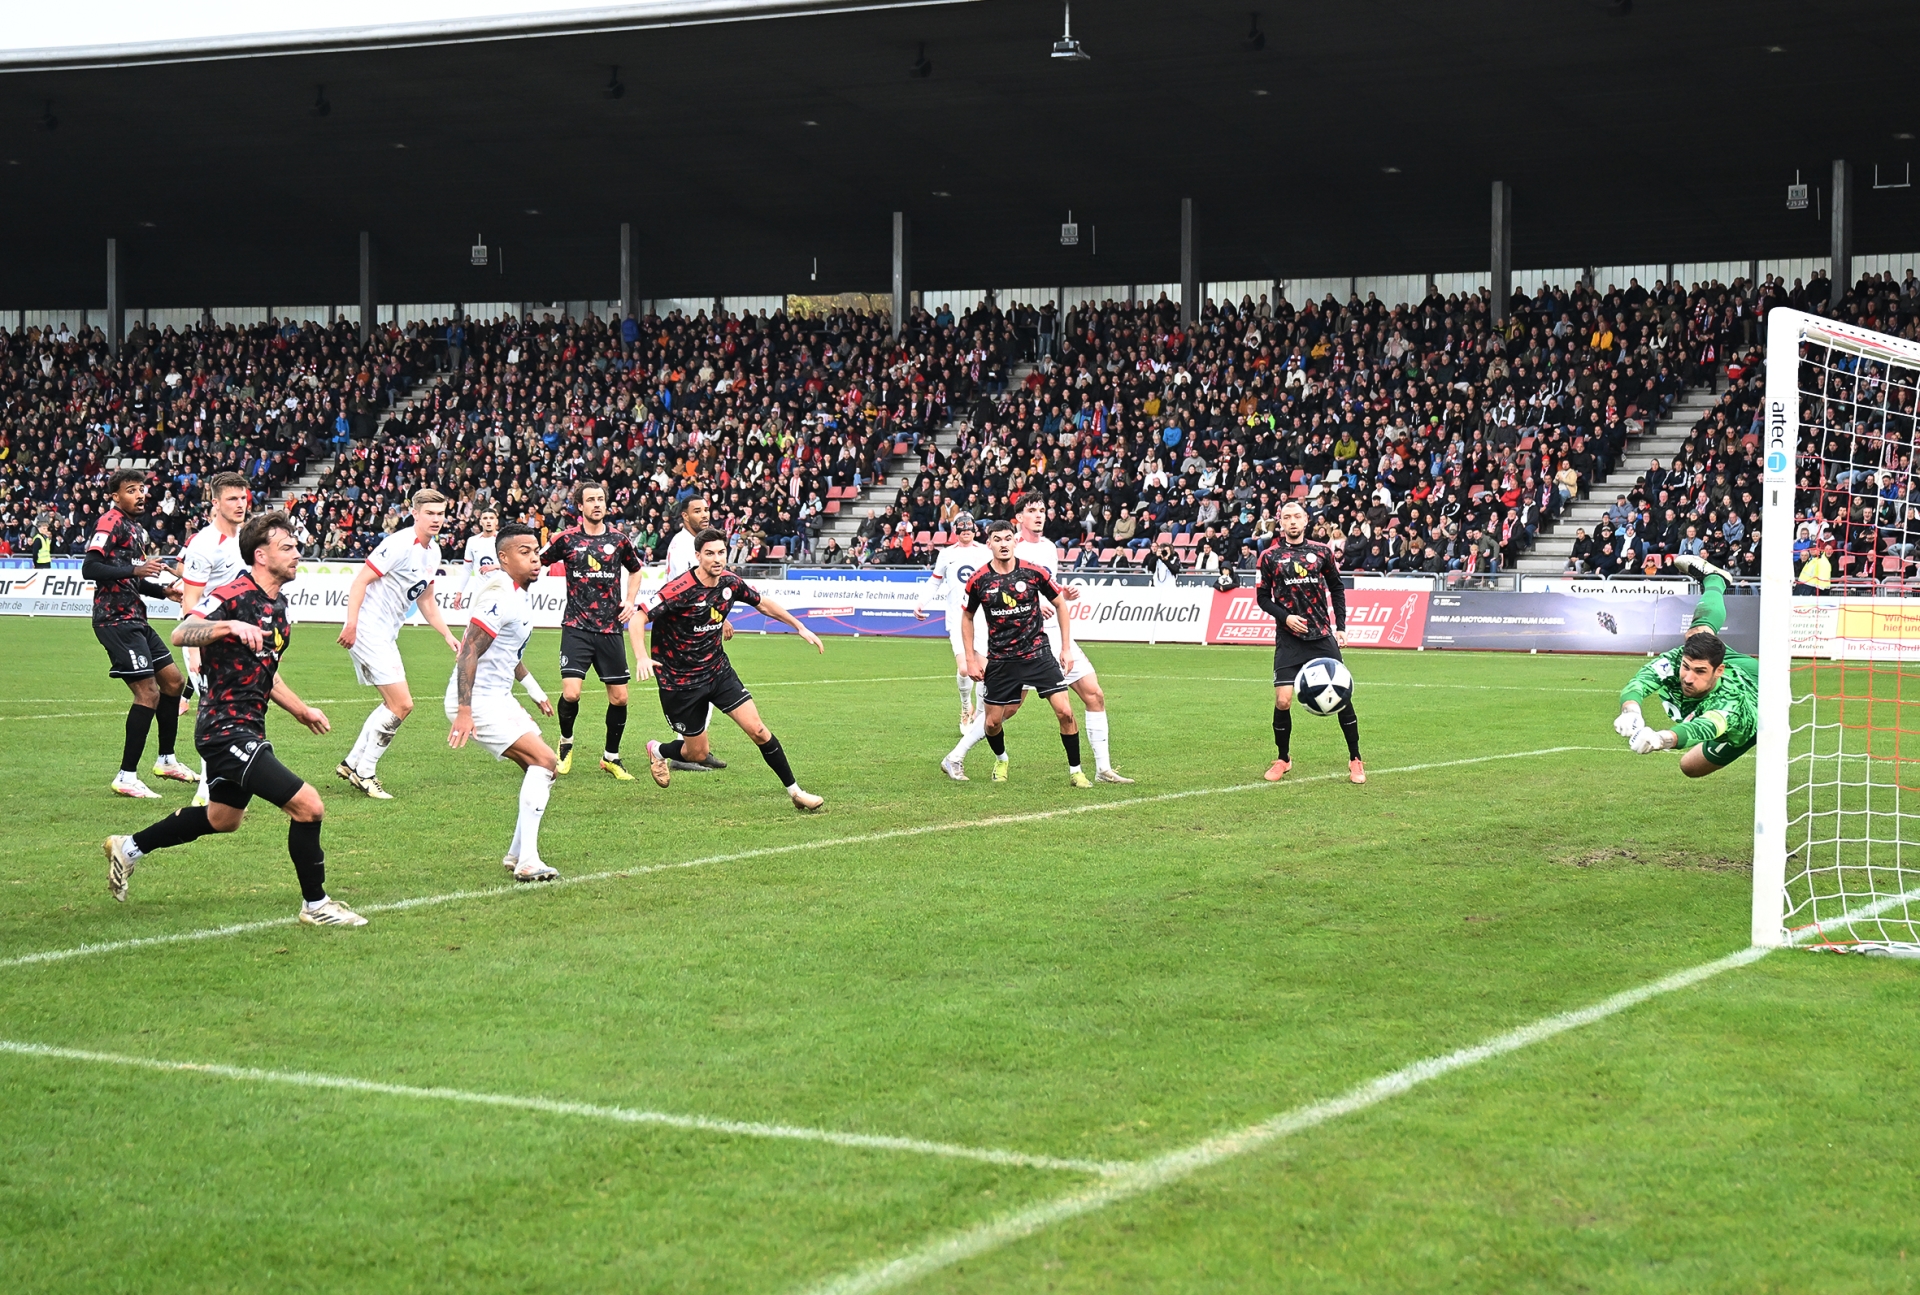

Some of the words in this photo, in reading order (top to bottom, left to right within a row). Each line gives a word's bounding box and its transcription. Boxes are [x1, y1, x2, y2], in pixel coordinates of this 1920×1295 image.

[1771, 401, 1787, 448] artec
[42, 575, 85, 596] Fehr
[325, 589, 350, 607] We
[813, 589, 864, 600] Löwenstarke
[866, 591, 896, 600] Technik
[897, 591, 919, 600] made
[34, 601, 50, 610] Fair
[51, 601, 59, 611] in
[60, 601, 92, 613] Entsorg
[531, 592, 566, 611] Wer
[146, 603, 169, 614] hr.de
[1430, 615, 1450, 623] BMW
[1450, 615, 1461, 623] AG
[1461, 616, 1502, 624] MOTORRAD
[1502, 617, 1538, 625] ZENTRUM
[1538, 617, 1566, 625] KASSEL
[1222, 626, 1261, 639] 34233
[1883, 624, 1902, 632] hier
[1847, 643, 1856, 651] In
